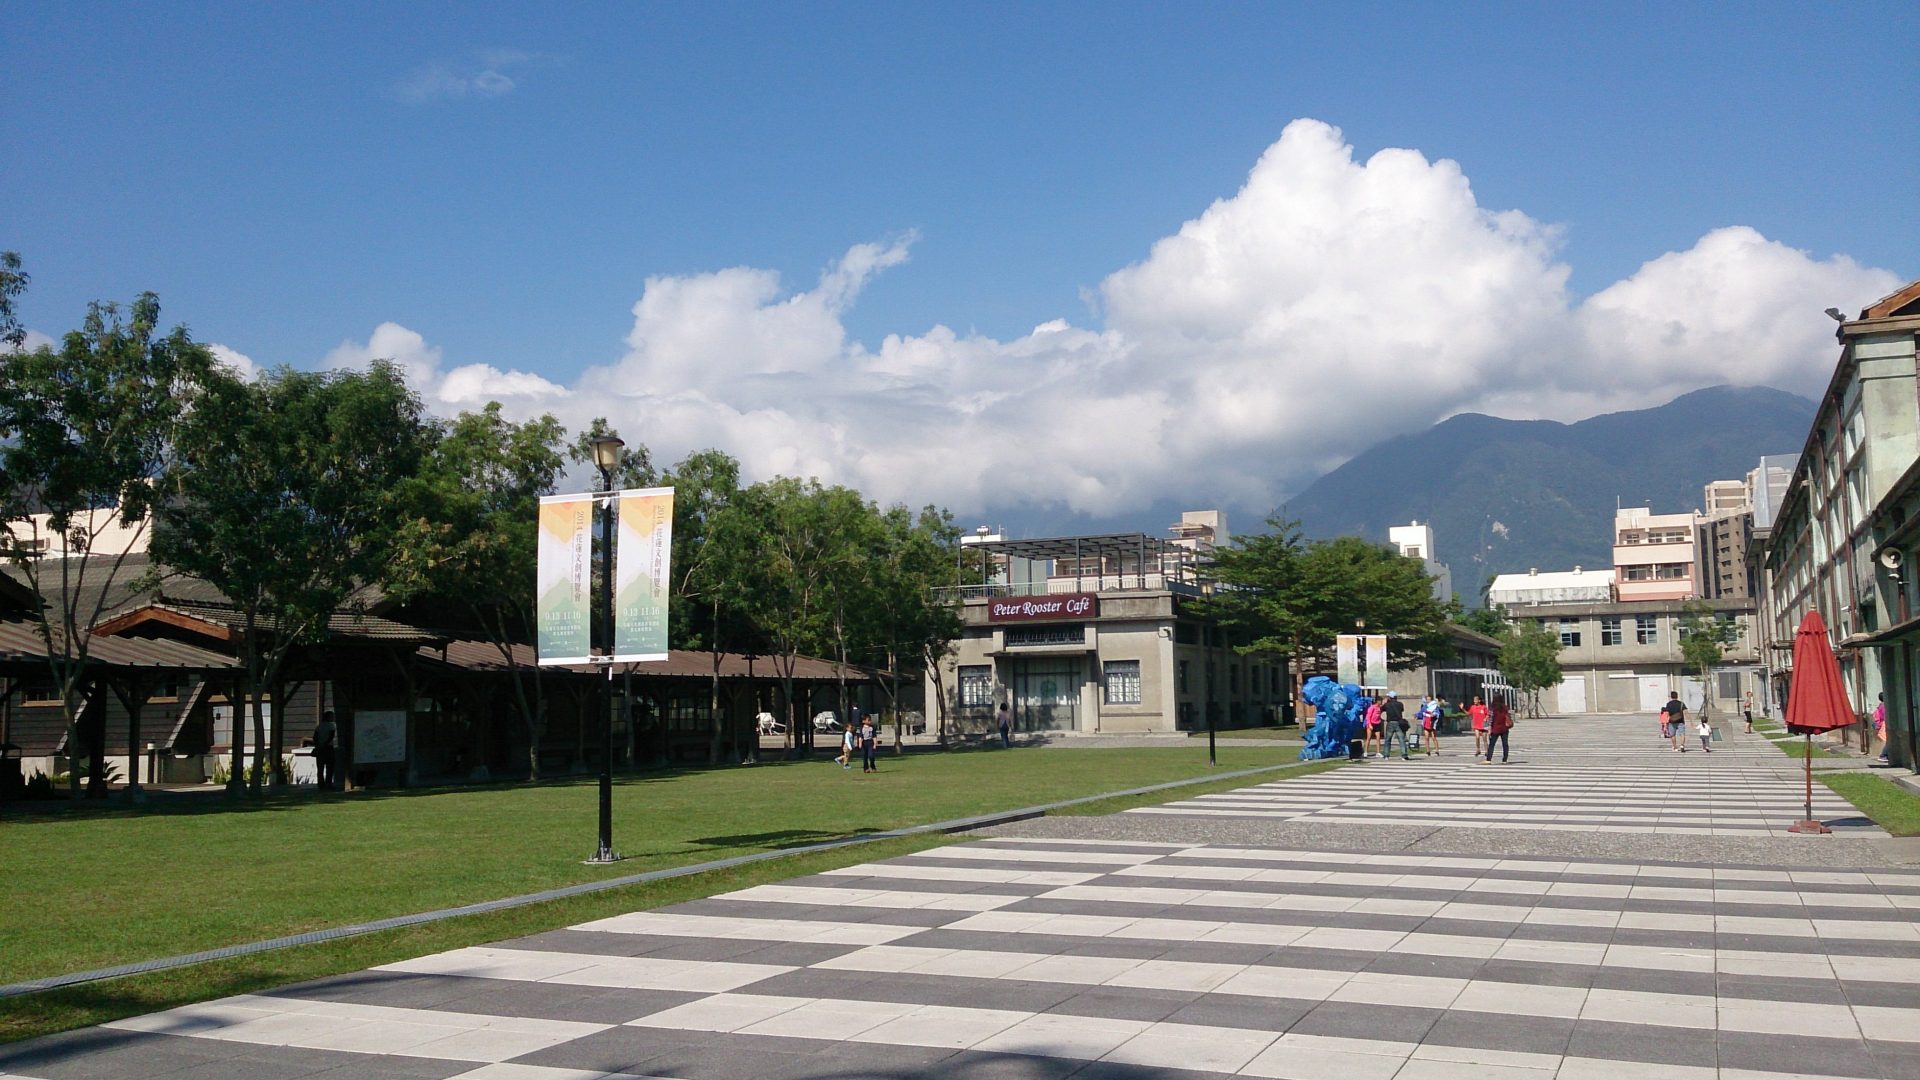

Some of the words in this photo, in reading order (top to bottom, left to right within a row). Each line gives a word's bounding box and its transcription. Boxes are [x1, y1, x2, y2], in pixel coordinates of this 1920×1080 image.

[993, 603, 1021, 616] Peter
[1022, 601, 1062, 616] Rooster
[1066, 597, 1090, 614] Café
